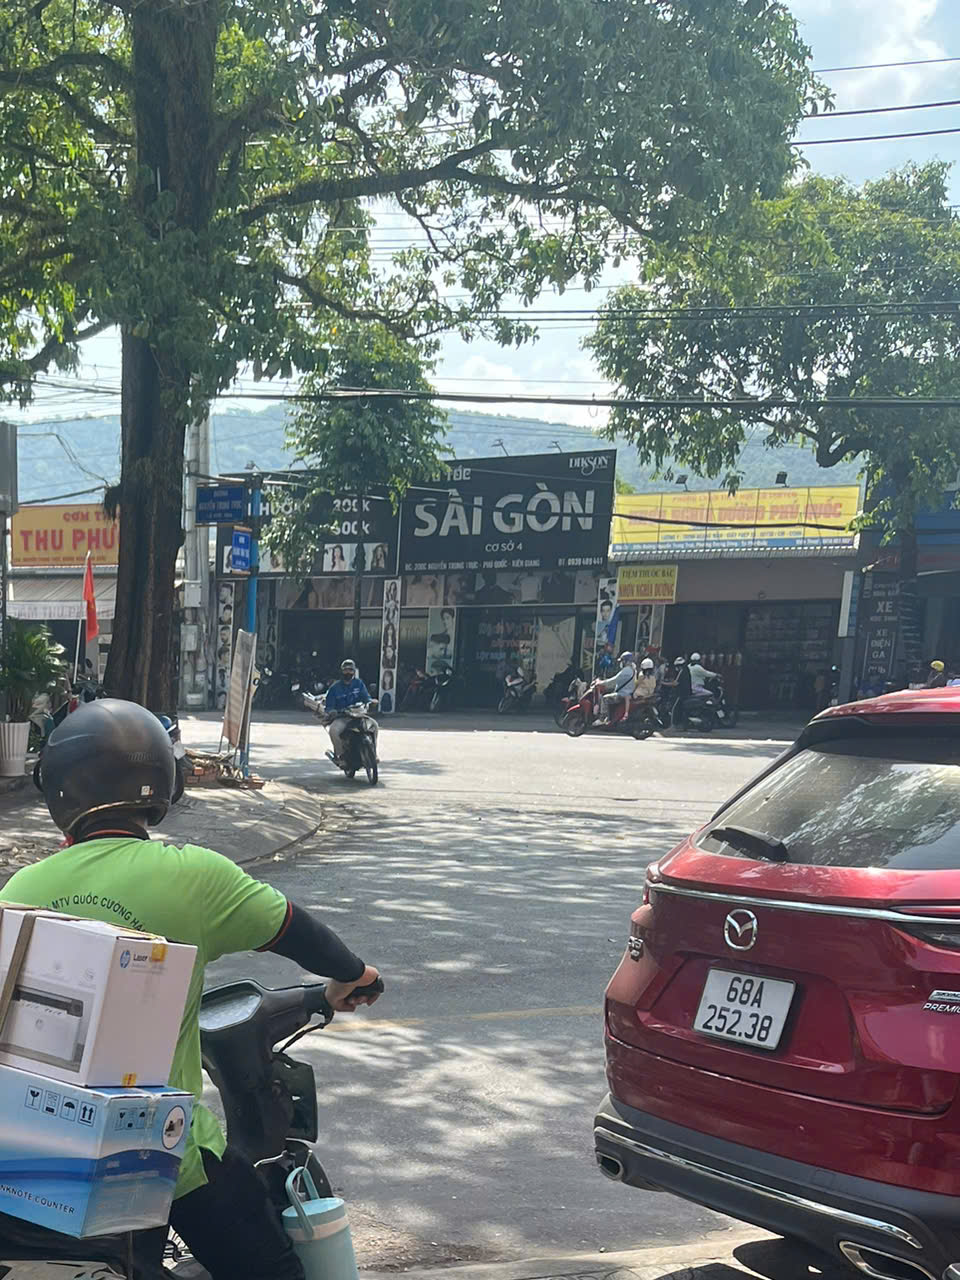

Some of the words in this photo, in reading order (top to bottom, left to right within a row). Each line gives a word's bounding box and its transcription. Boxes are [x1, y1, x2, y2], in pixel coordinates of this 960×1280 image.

[414, 488, 484, 537] SÀI
[493, 482, 595, 533] GÒN
[20, 529, 64, 552] THU
[72, 523, 118, 552] PHƯ
[876, 601, 894, 613] XE
[52, 896, 70, 909] MTV
[73, 891, 98, 905] QUỐC
[100, 897, 133, 921] CƯỜNG
[726, 977, 764, 1008] 68A
[702, 1004, 773, 1042] 252.38
[34, 1195, 75, 1214] COUNTER
